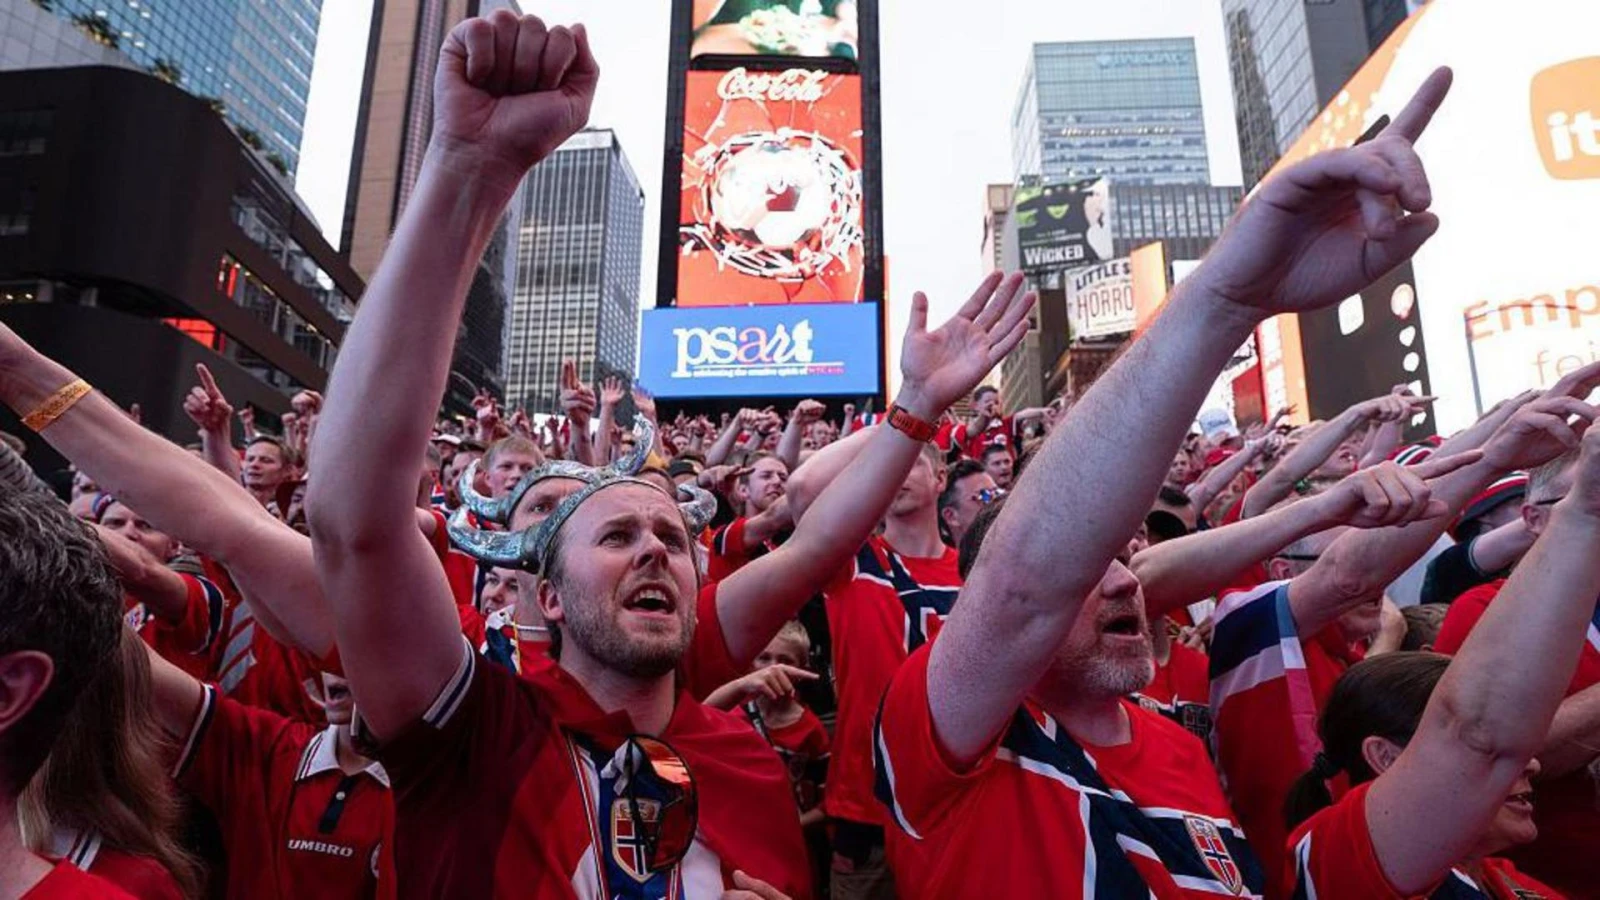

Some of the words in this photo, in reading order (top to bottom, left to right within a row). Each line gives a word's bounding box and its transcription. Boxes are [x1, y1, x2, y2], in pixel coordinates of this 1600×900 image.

[1547, 110, 1600, 162] it
[1076, 263, 1119, 291] LITTLE
[1464, 285, 1600, 341] Emp
[671, 319, 813, 378] psart
[287, 839, 354, 857] UMBRO
